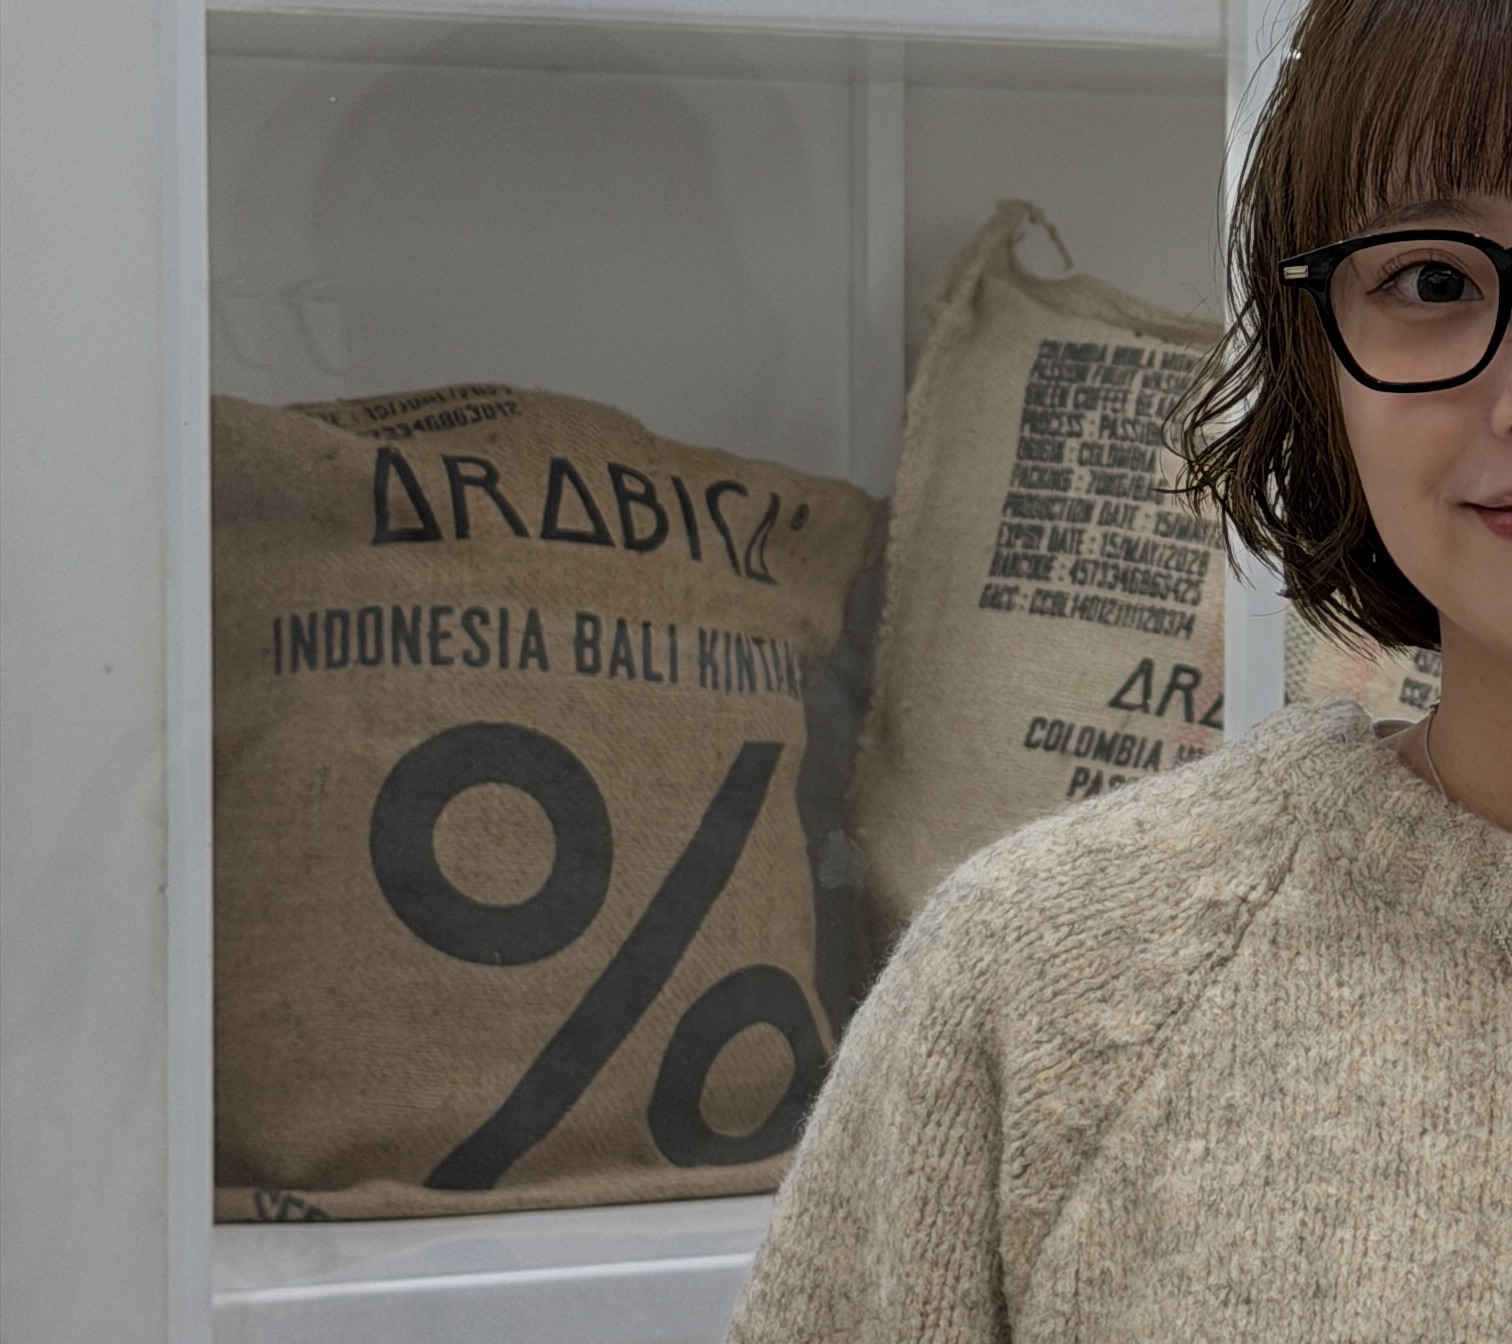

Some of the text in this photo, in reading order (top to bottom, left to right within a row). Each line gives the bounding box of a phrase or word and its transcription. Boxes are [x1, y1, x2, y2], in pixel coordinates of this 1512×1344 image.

[1046, 523, 1086, 555] DATE
[273, 604, 550, 676] INDONESIA
[573, 609, 680, 685] BALI
[1024, 715, 1164, 773] COLOMBIA
